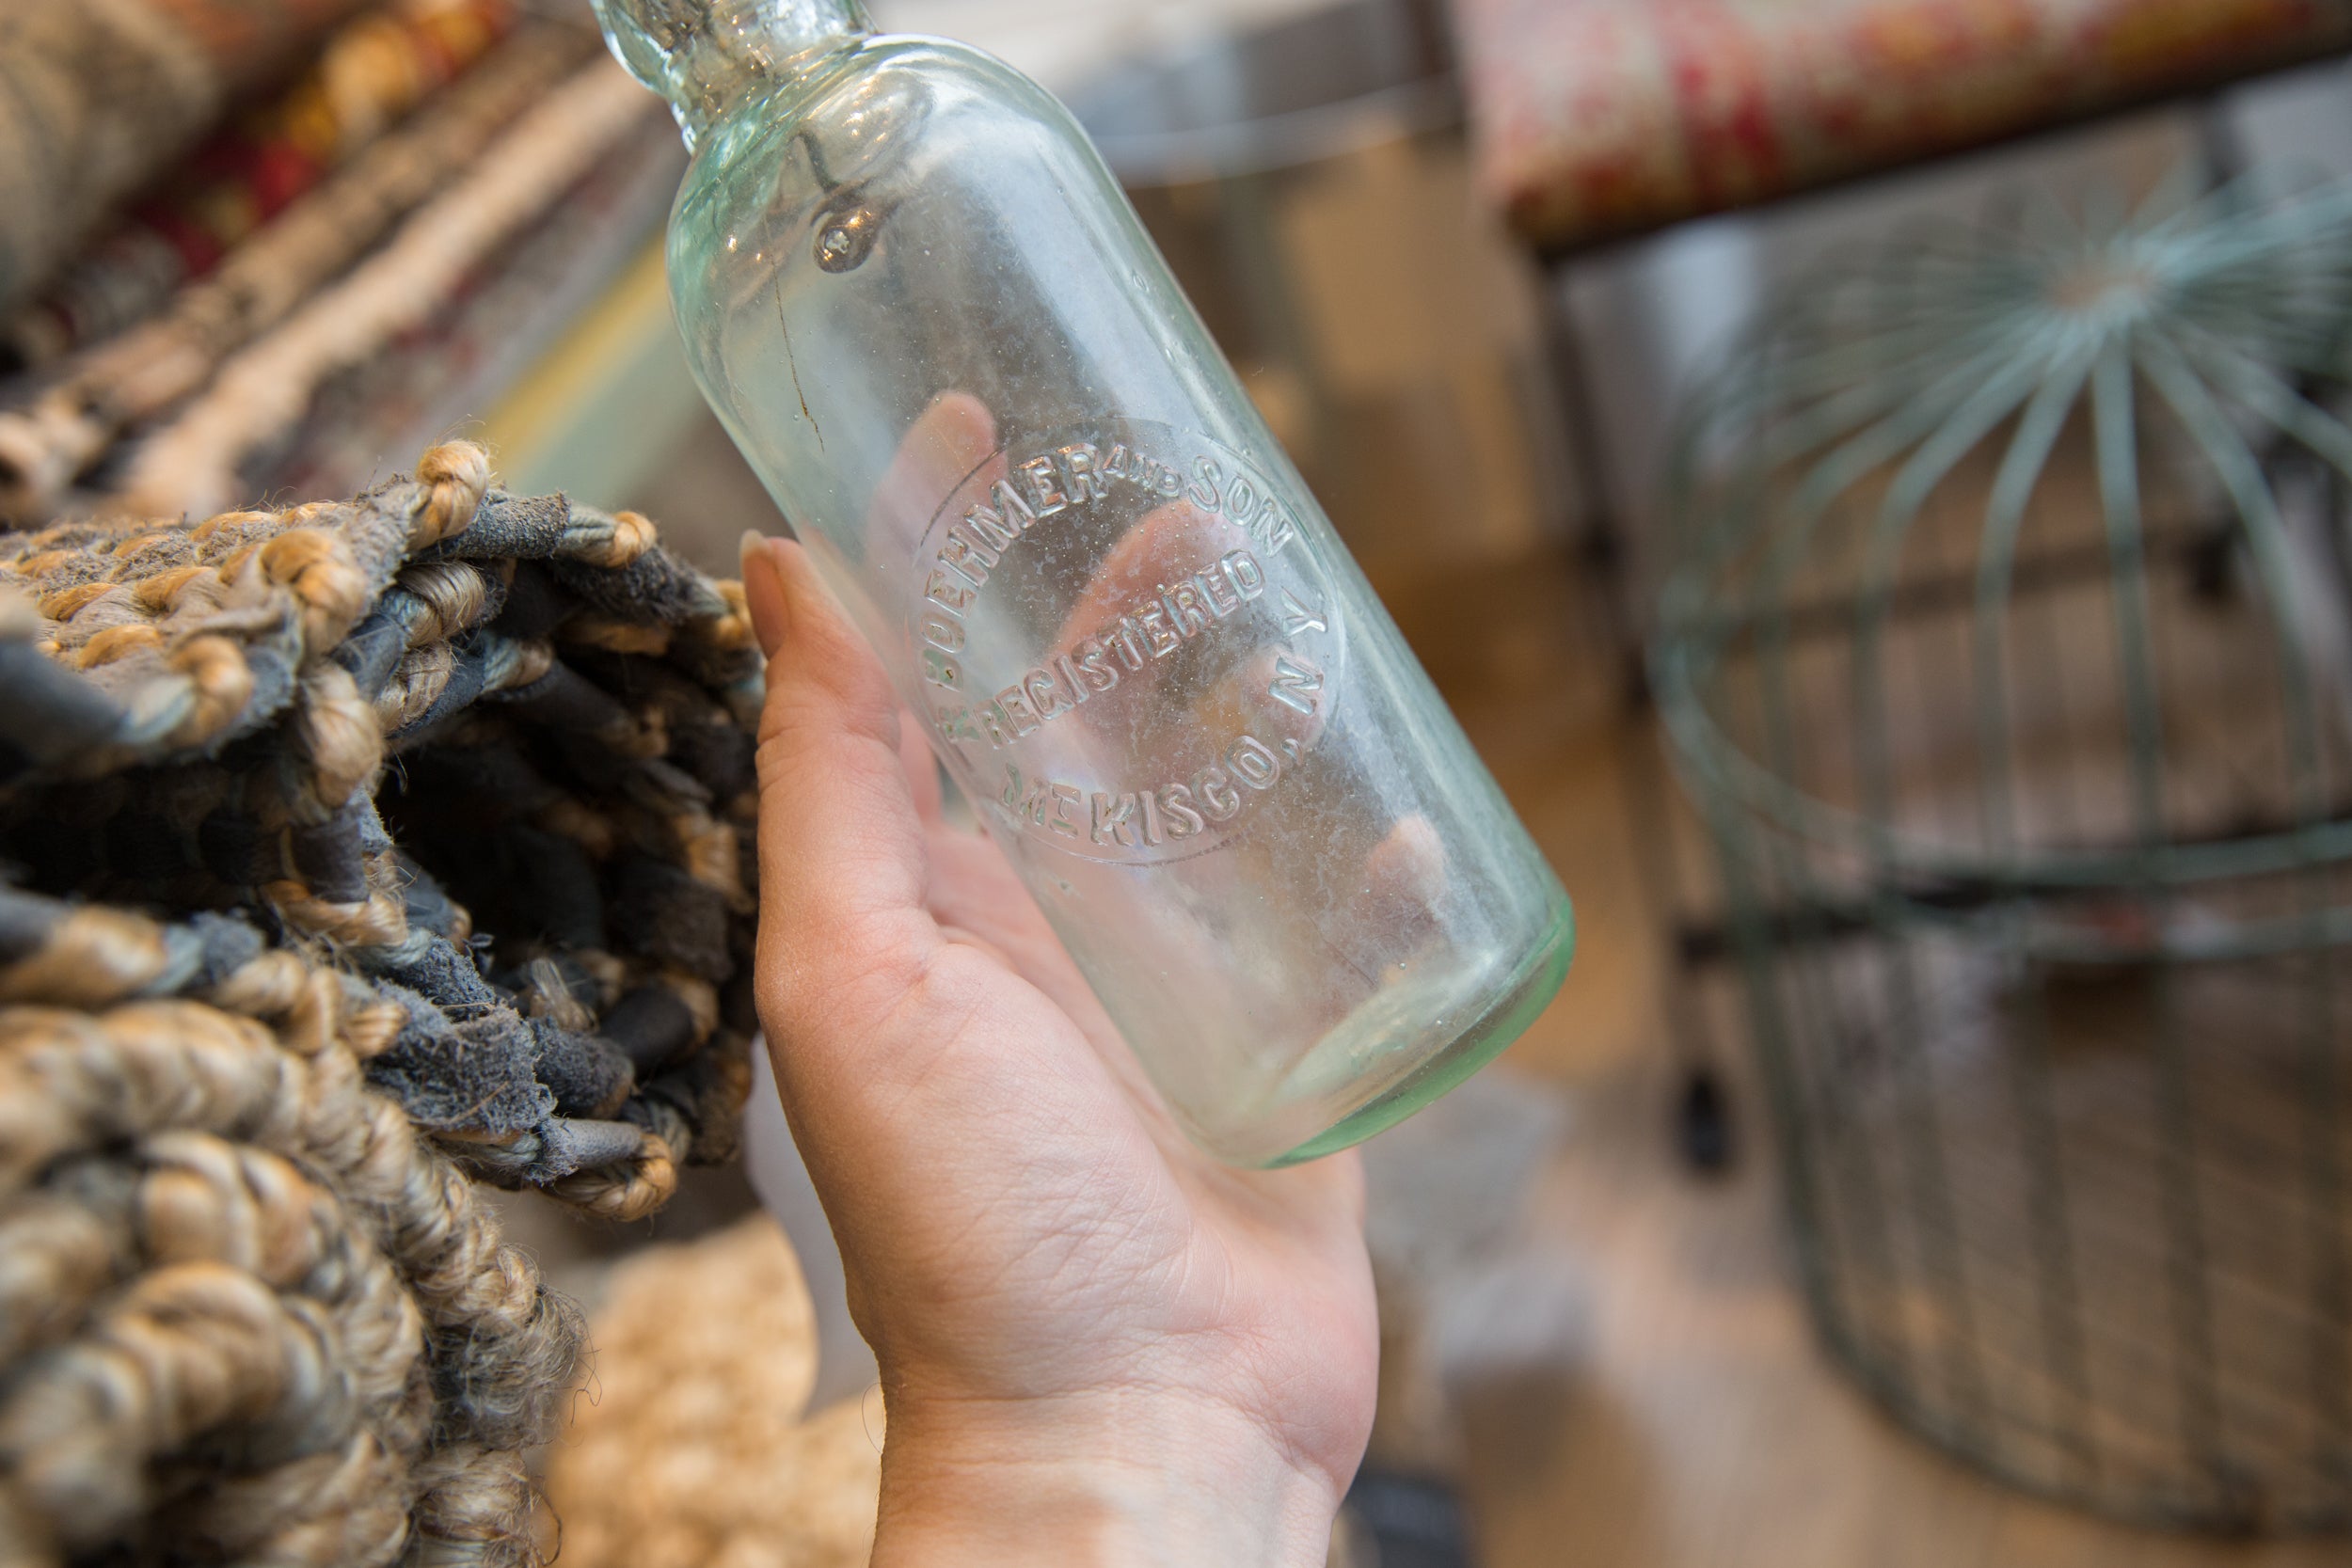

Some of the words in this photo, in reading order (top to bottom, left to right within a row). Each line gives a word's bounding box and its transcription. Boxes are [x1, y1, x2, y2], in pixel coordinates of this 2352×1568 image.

[919, 442, 1110, 693] BOEHMER
[1187, 454, 1295, 558] SON
[972, 548, 1265, 751] REGISTERED
